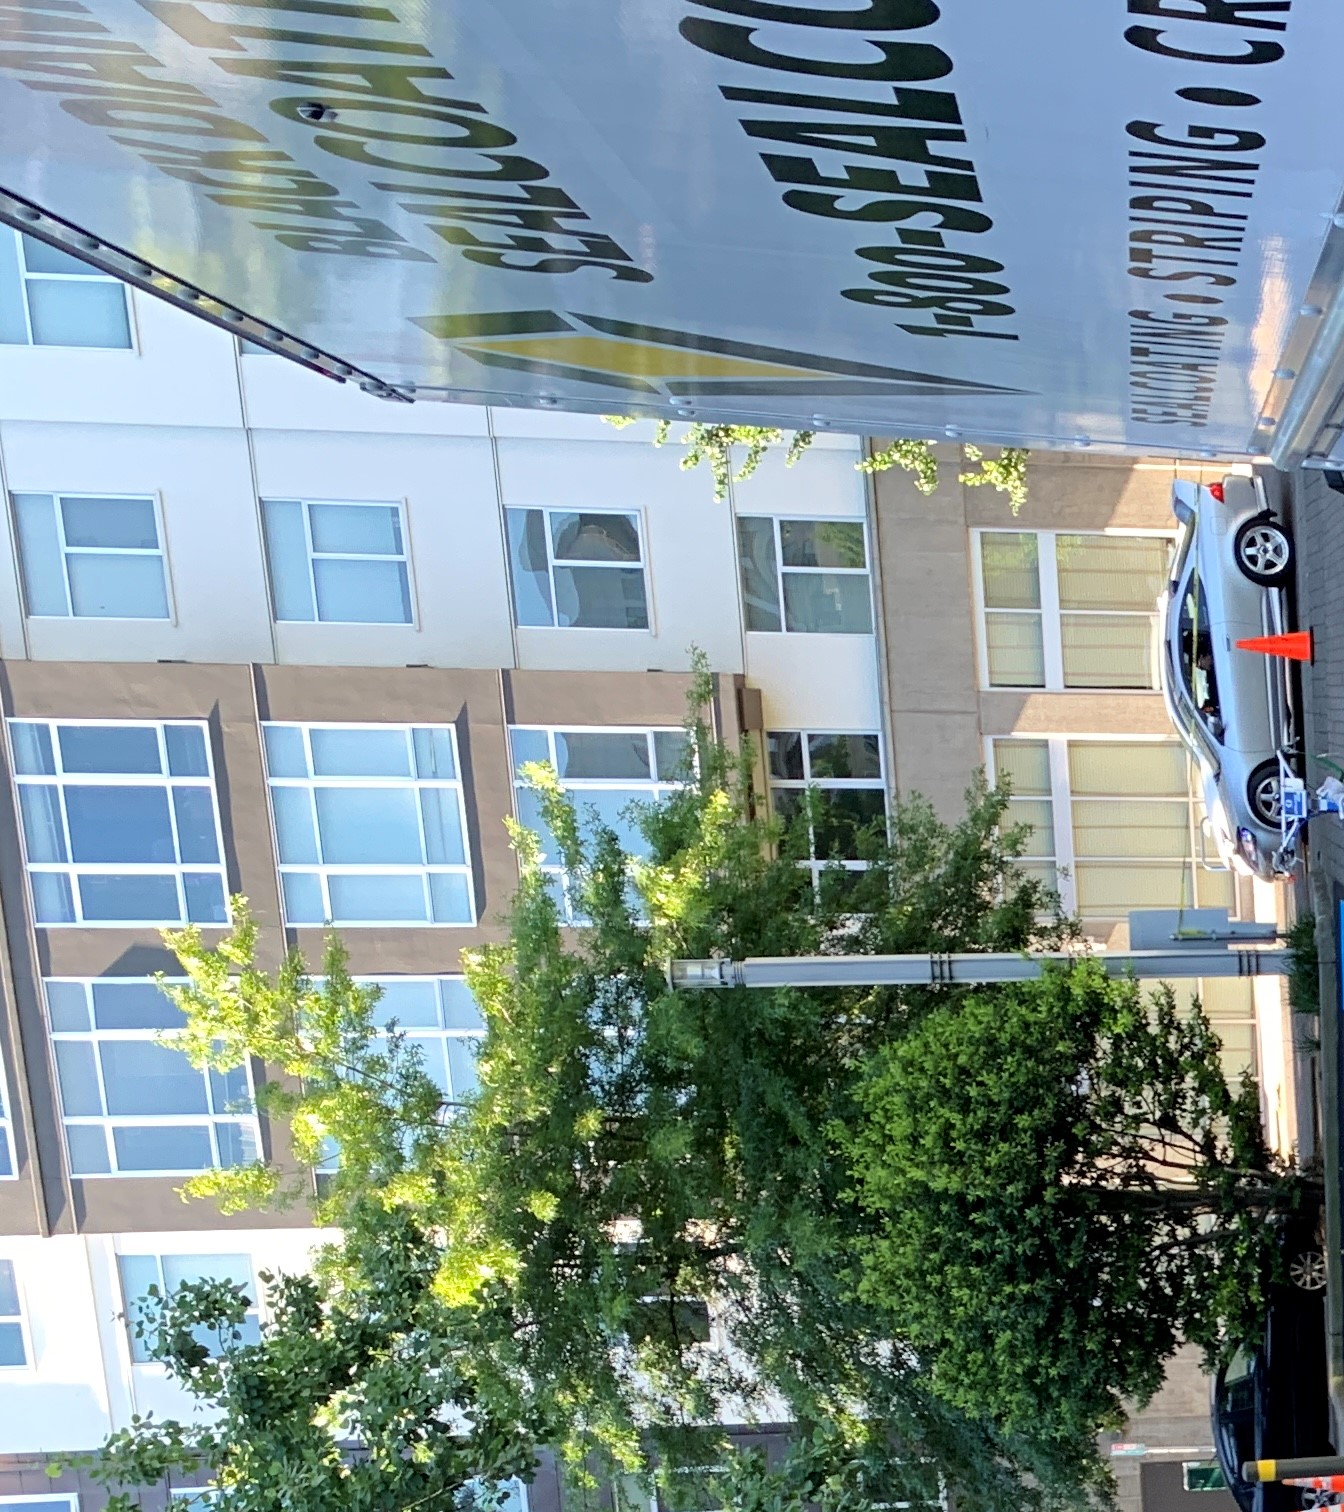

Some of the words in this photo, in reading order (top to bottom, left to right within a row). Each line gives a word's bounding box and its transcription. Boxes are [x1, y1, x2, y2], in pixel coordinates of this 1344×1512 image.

[106, 135, 438, 263] BLACK
[1124, 119, 1267, 286] STRIPING
[1127, 309, 1229, 427] SEALCOATING
